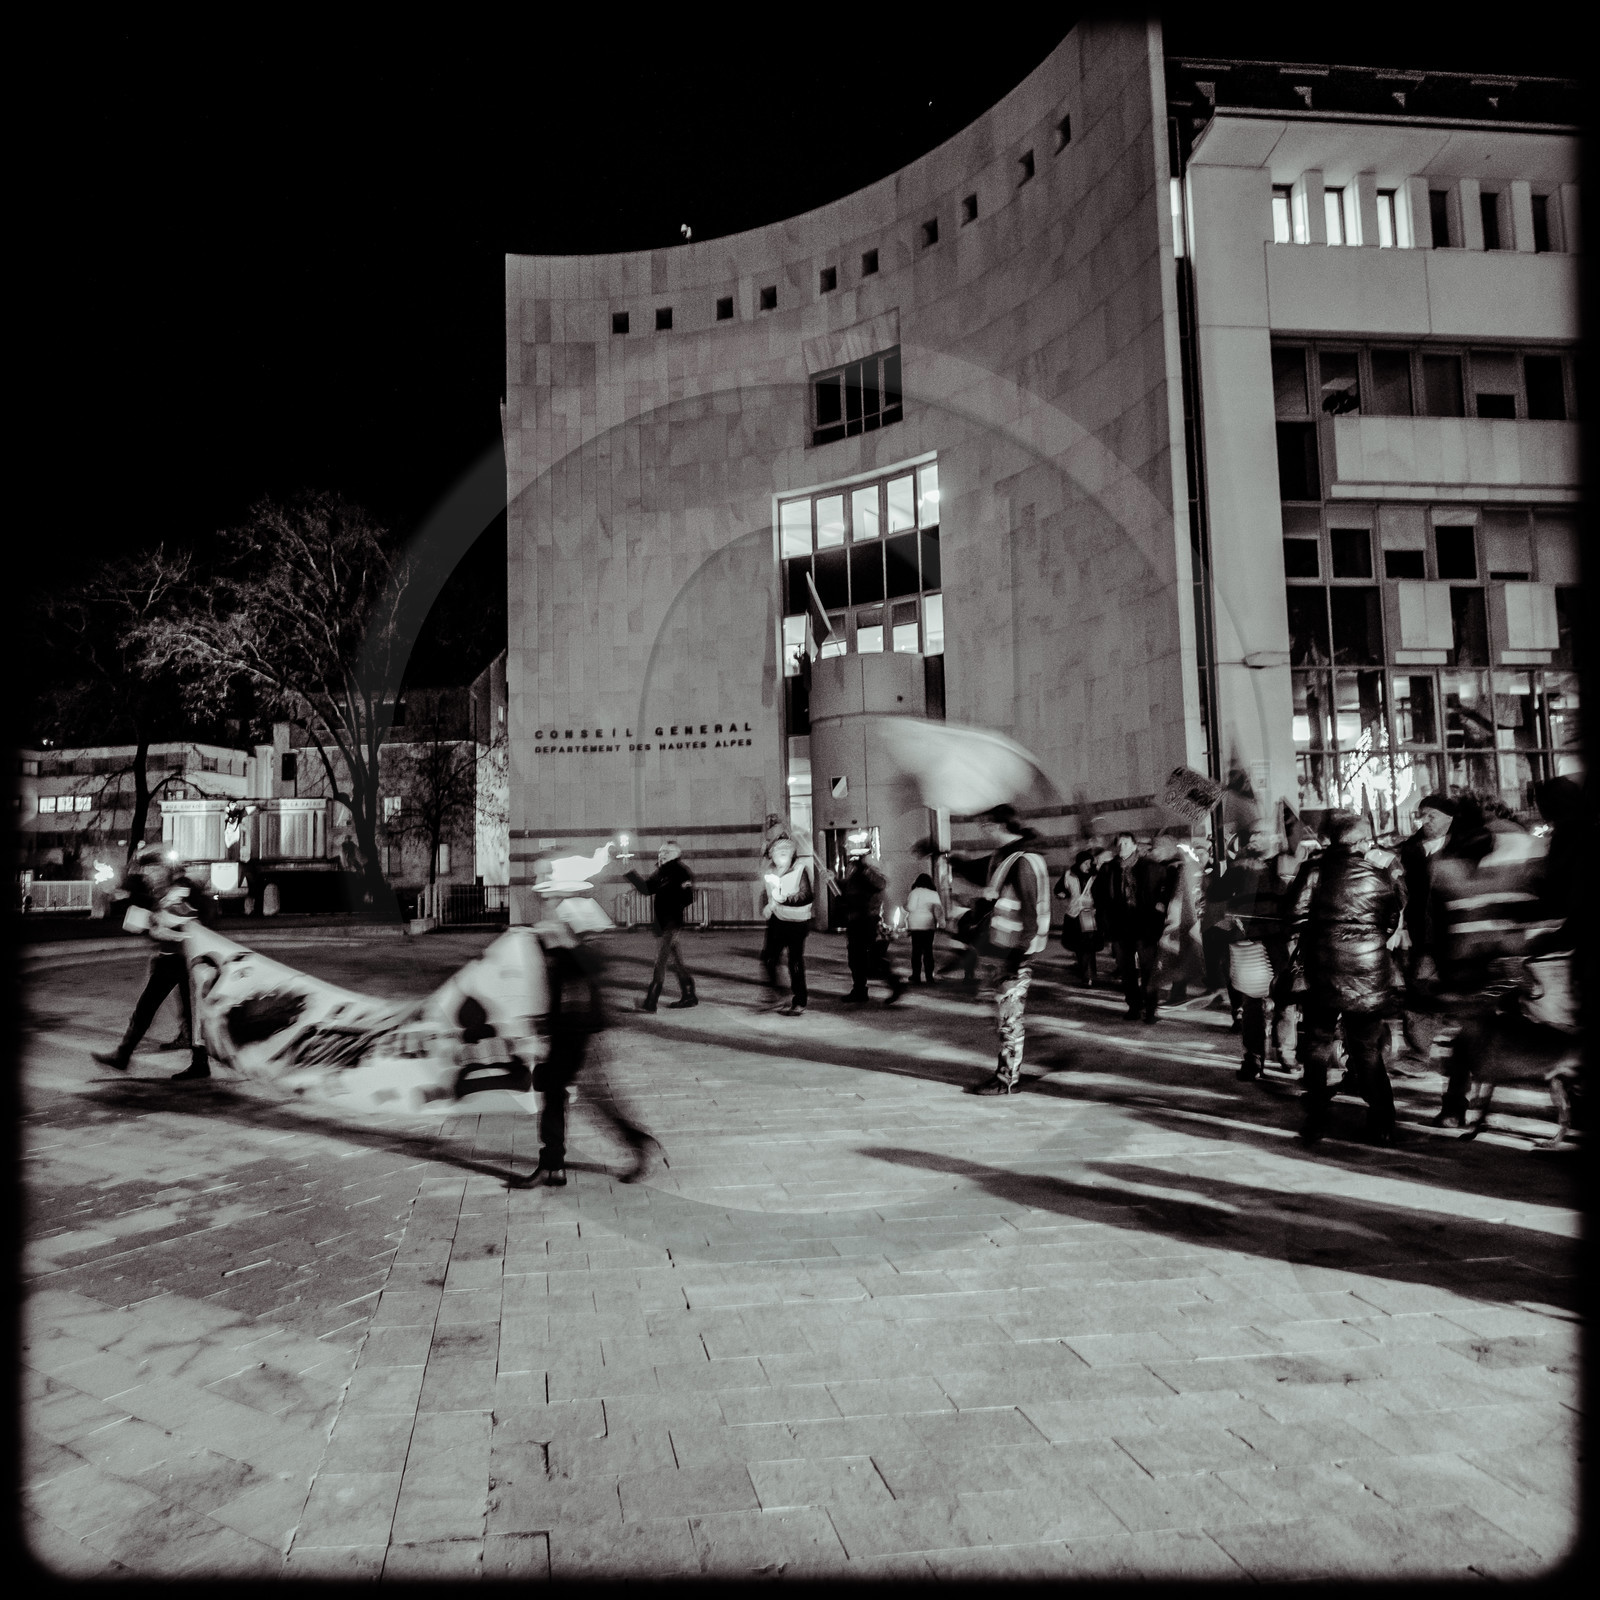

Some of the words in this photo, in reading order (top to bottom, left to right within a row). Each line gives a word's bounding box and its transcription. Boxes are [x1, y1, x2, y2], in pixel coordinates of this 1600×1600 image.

[534, 728, 633, 740] CONSEIL
[655, 722, 752, 736] GENERAL
[534, 744, 621, 754] DEPARTEMENT
[628, 743, 652, 752] DES
[659, 741, 707, 751] HAUTES
[715, 738, 752, 749] ALPES
